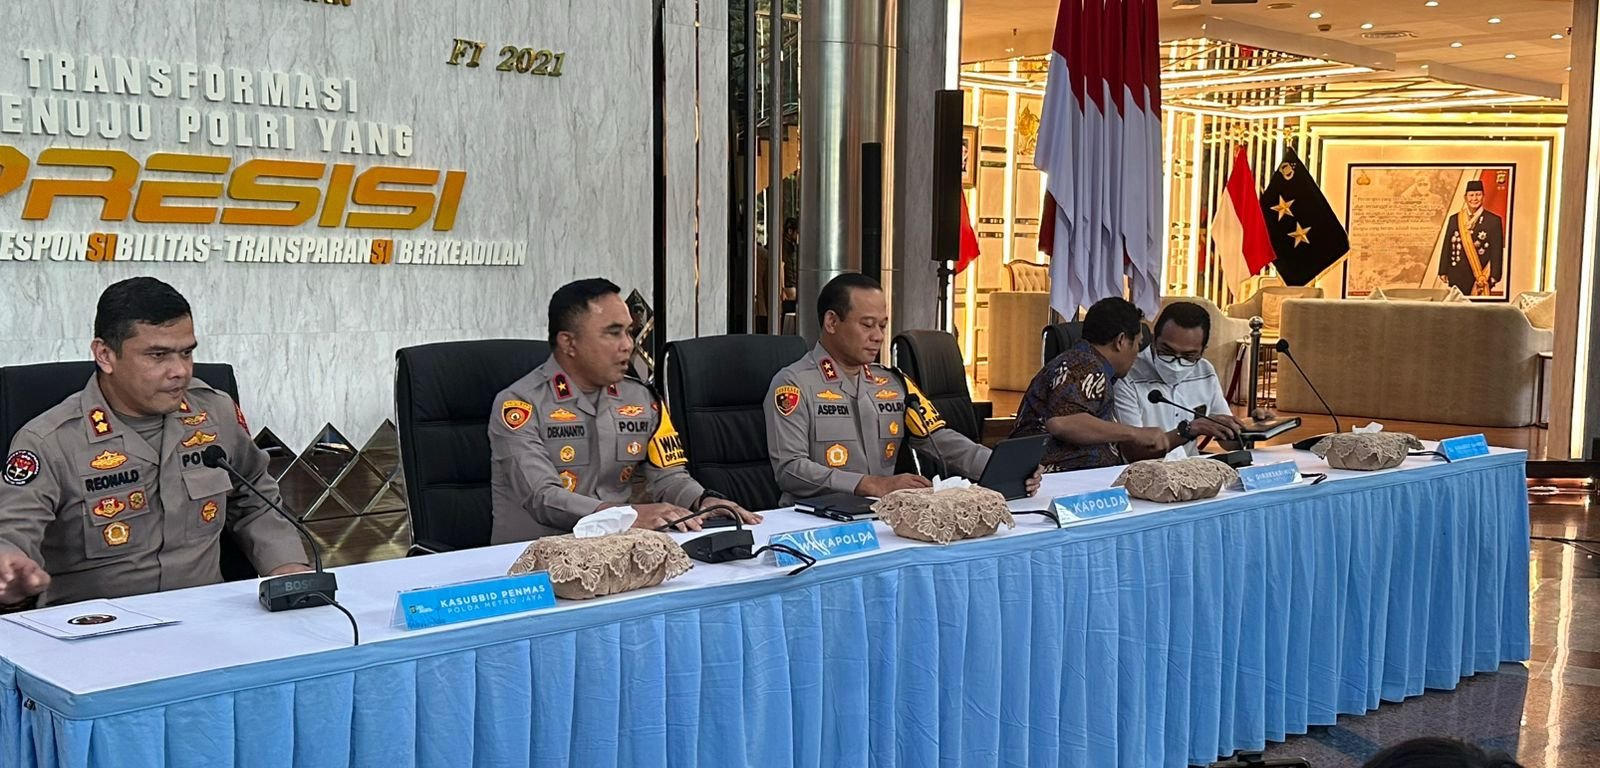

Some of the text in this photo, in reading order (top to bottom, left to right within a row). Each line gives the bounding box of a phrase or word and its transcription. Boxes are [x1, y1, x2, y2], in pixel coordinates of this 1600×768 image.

[446, 38, 565, 77] FI 2021
[21, 48, 358, 113] TRANSFORMASI
[177, 106, 295, 150] POLRI
[314, 117, 413, 157] YANG
[396, 238, 528, 267] BERKEADILAN
[878, 402, 904, 413] POLRI
[547, 425, 585, 439] DEKANANTO
[618, 421, 648, 433] POLRI
[85, 469, 139, 493] REONALD
[1073, 495, 1127, 514] KAPOLDA
[440, 584, 546, 608] KASUBBID PENMAS
[447, 604, 480, 614] POLDA
[484, 597, 517, 608] METRO
